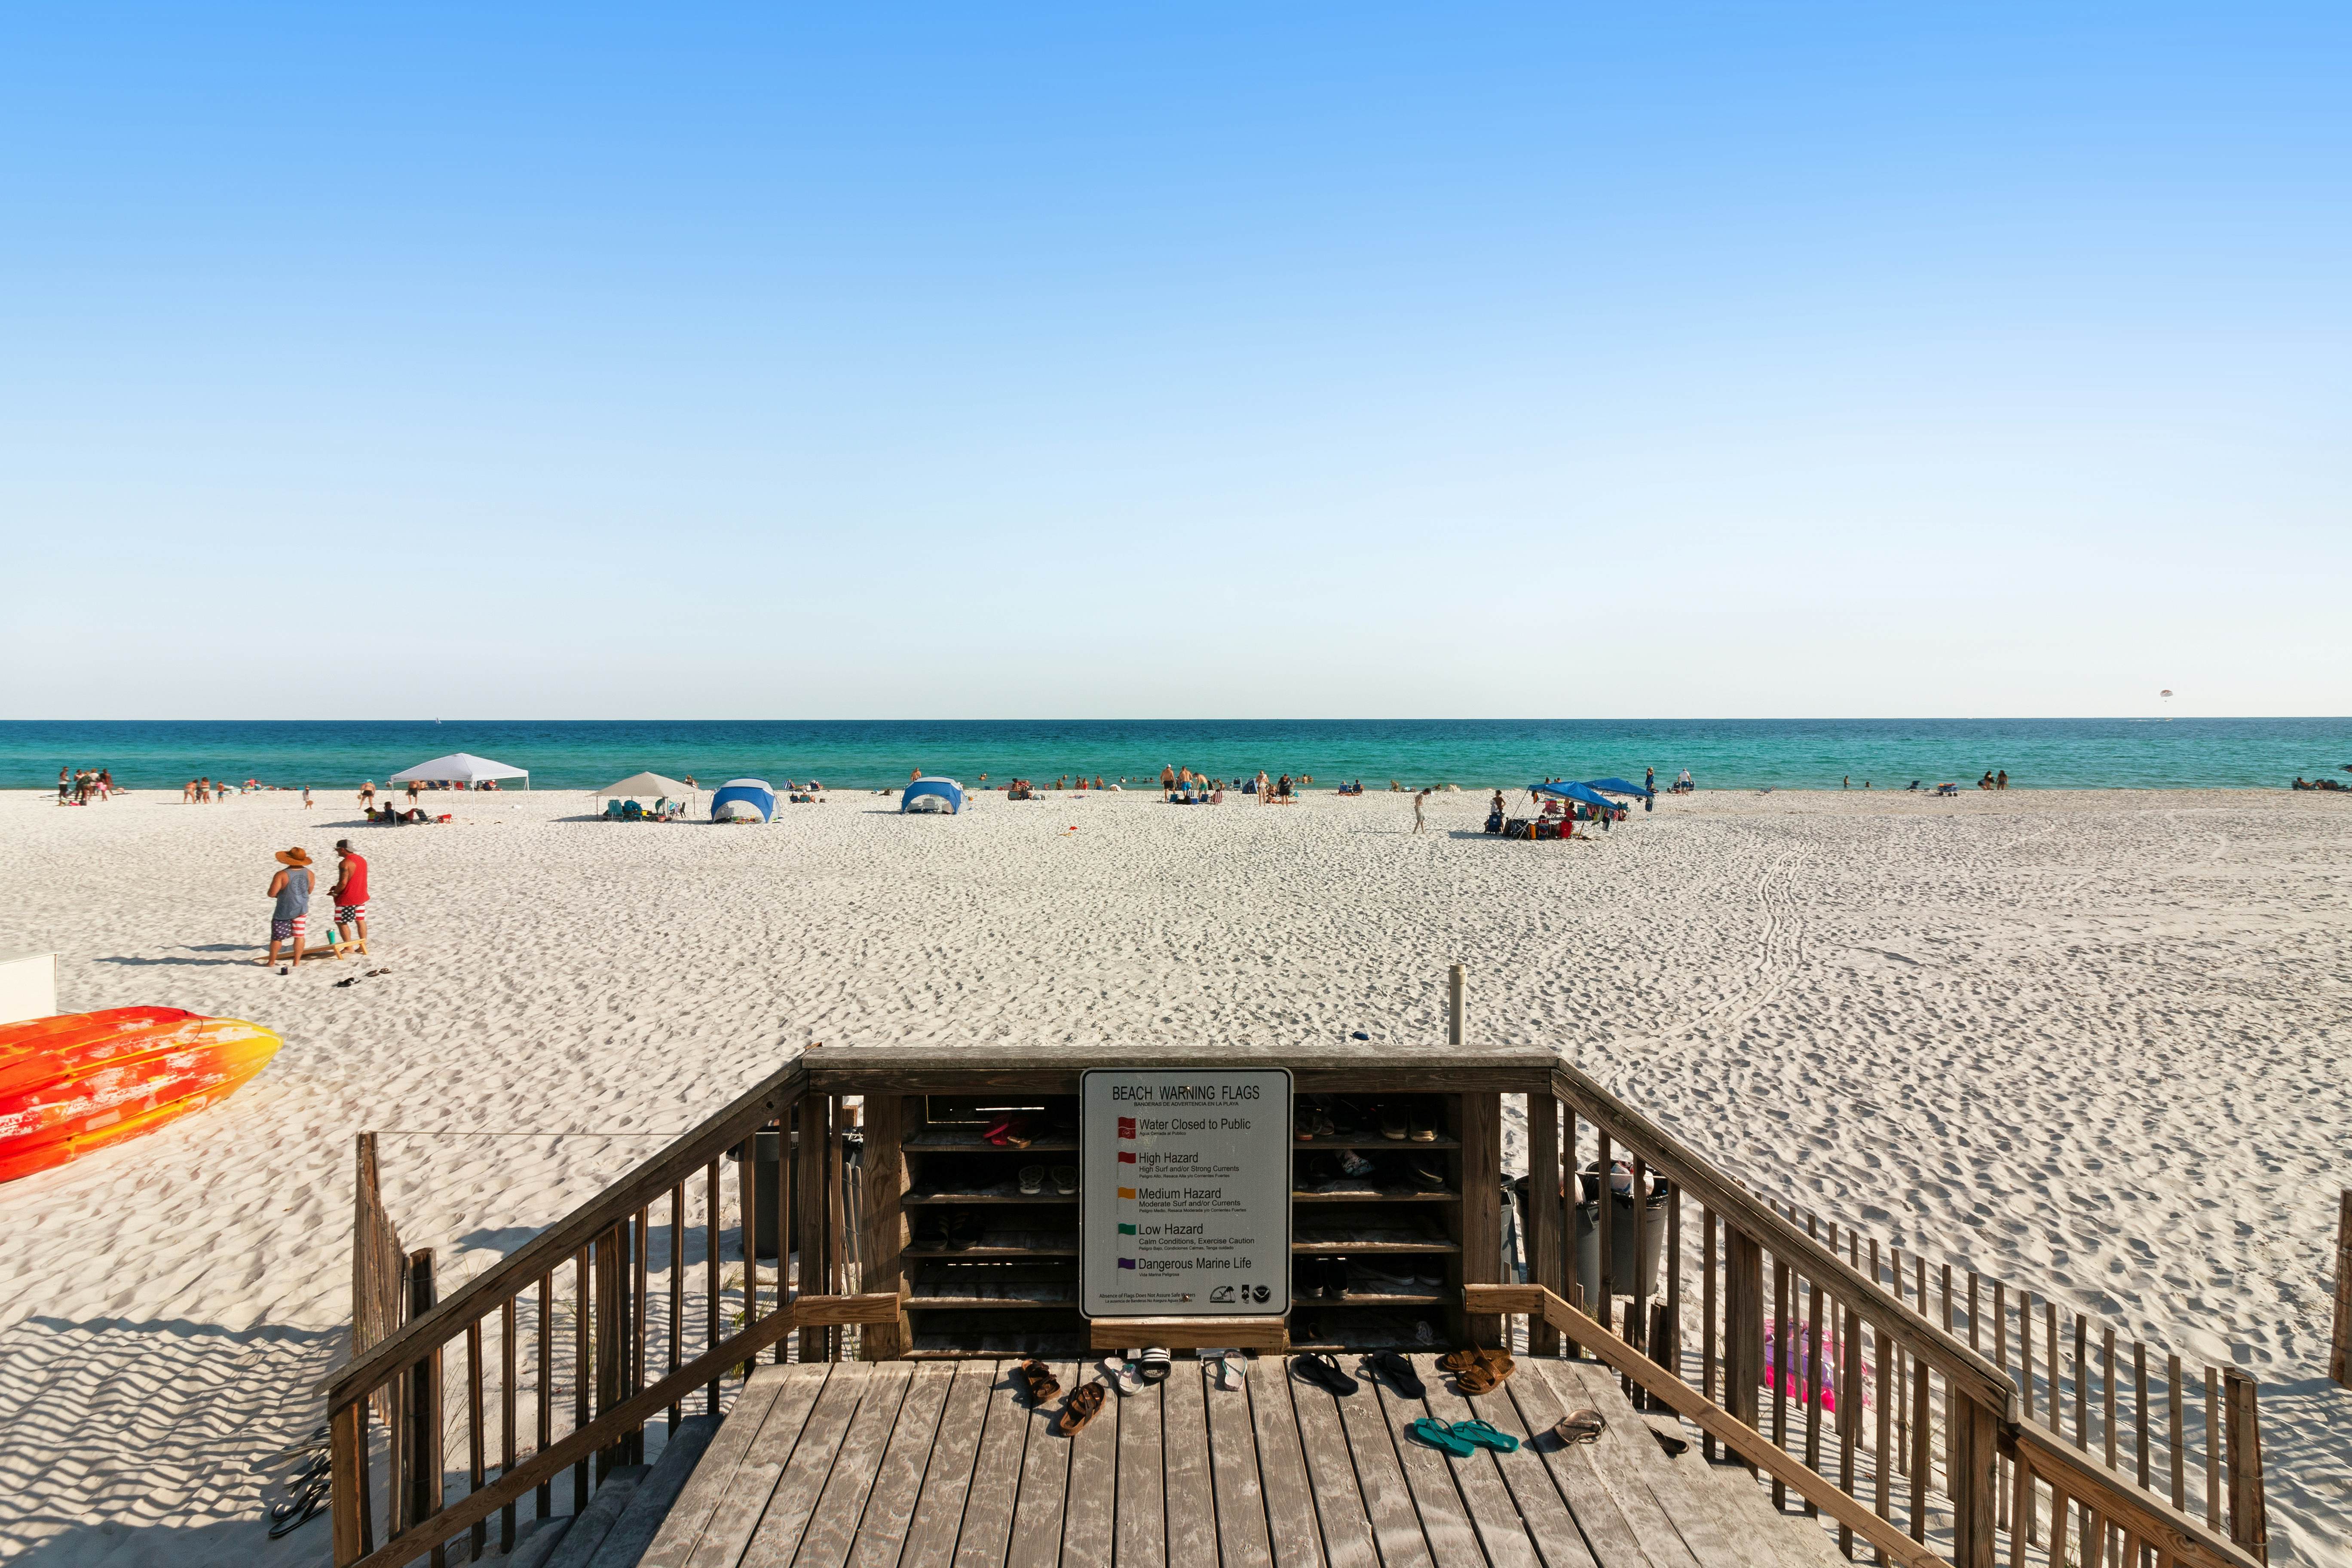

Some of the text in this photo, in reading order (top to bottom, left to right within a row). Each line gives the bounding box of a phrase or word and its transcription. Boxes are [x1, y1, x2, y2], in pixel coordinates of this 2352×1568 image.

[1113, 1085, 1260, 1100] BEACH WARNING FLAGS
[1139, 1118, 1251, 1130] Water Closed to Public
[1139, 1152, 1198, 1166] High Hazard
[1139, 1188, 1221, 1199] Medium Hazard
[1139, 1223, 1203, 1234] Low Hazard
[1139, 1257, 1251, 1271] Dangerous Marine Life
